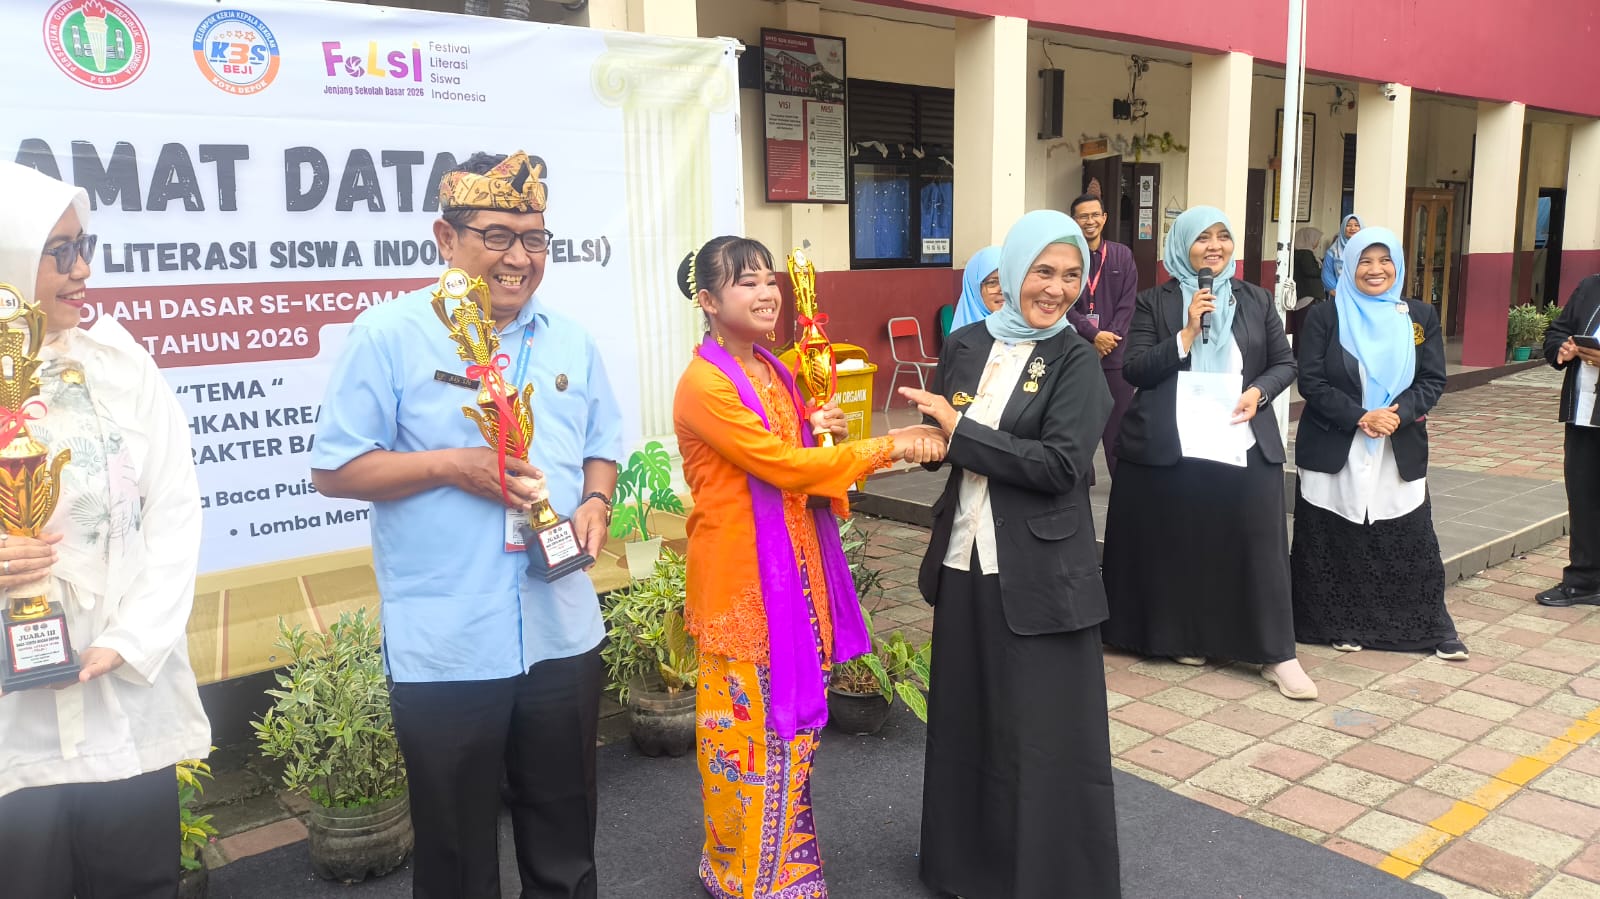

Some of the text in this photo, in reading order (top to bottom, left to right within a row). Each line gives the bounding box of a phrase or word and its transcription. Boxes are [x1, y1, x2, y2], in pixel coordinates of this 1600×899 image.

[210, 41, 266, 65] K3S
[429, 41, 471, 54] Festival
[223, 64, 253, 75] BEJI
[430, 56, 468, 70] Literasi
[90, 75, 118, 84] PGRI
[212, 76, 237, 93] KOTA
[430, 72, 461, 85] Siswa
[323, 84, 425, 97] Jenjang Sekolah Dasar 2026
[431, 88, 487, 102] Indonesia
[778, 100, 791, 110] VISI
[820, 105, 834, 113] MISI
[103, 235, 612, 273] LITERASI SISWA INDO ELSI)
[159, 296, 255, 319] DASAR
[142, 327, 309, 356] TAHUN 2026
[215, 486, 271, 507] Baca
[250, 515, 321, 537] Lomba
